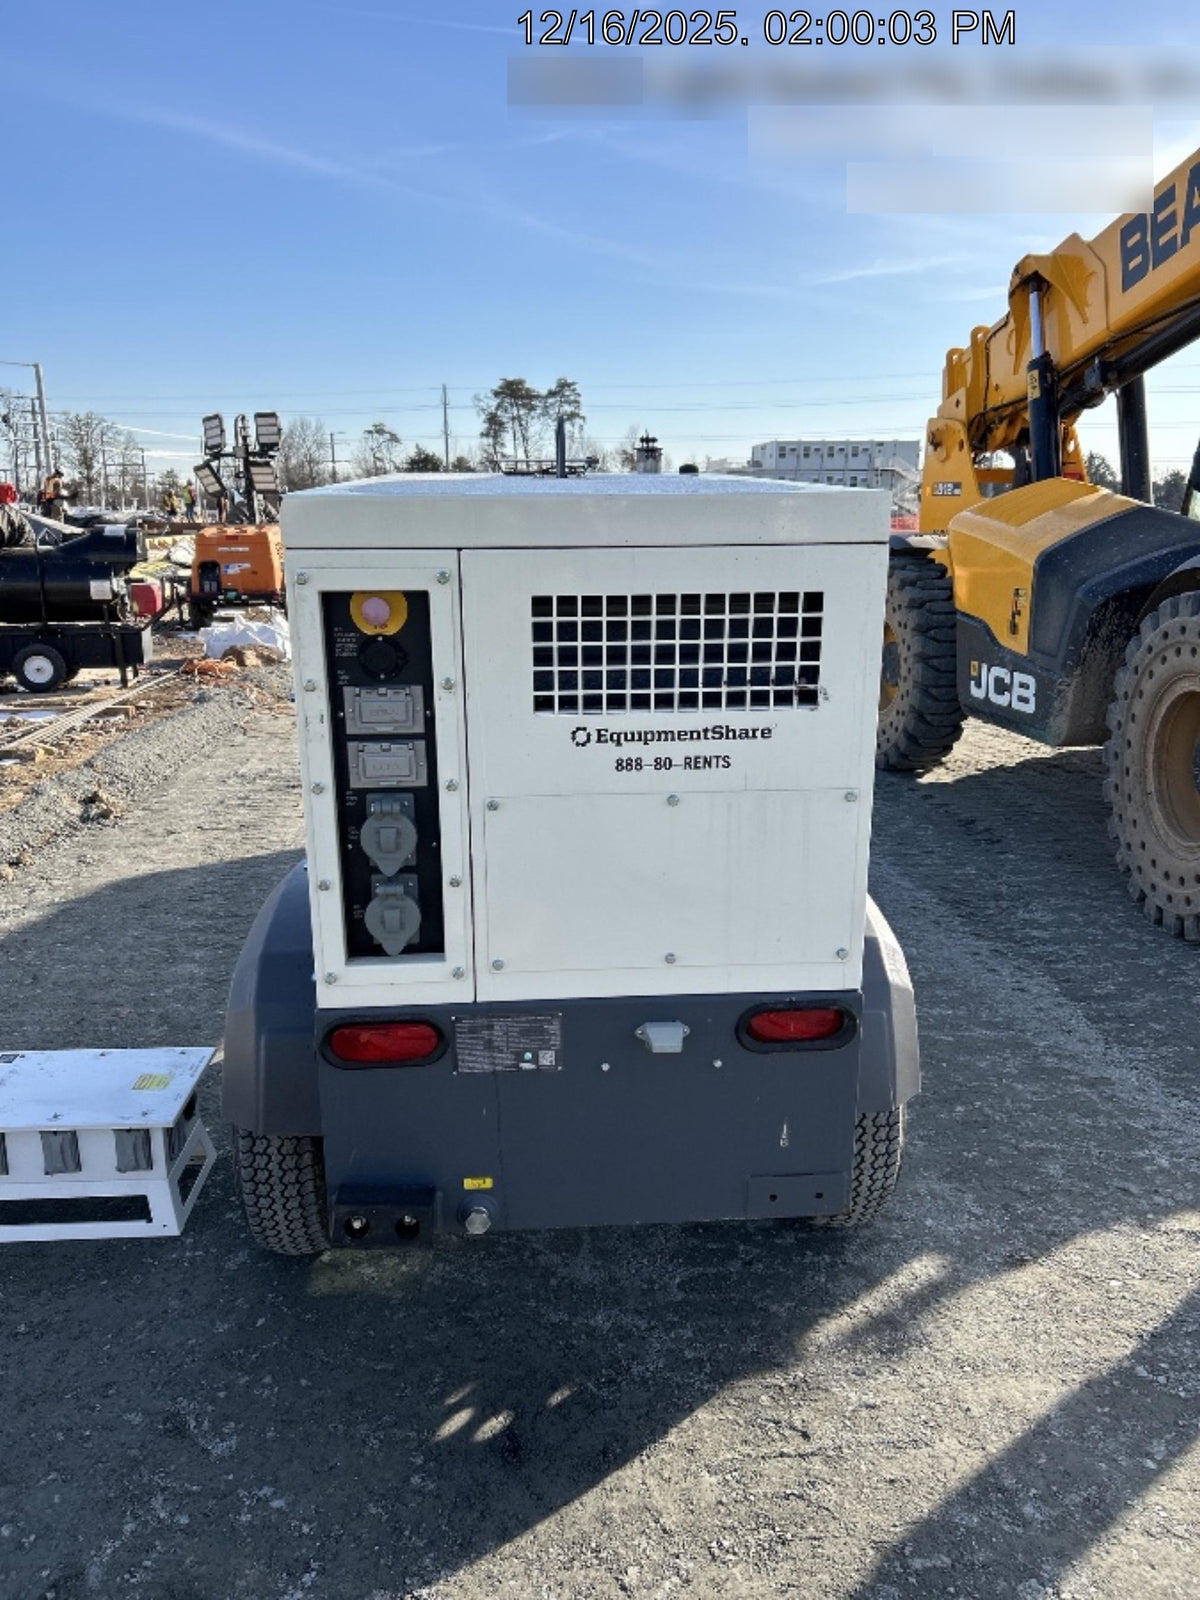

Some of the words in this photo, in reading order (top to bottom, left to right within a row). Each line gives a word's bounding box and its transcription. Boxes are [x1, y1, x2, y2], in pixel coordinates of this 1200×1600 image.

[970, 662, 1036, 714] JCB
[595, 725, 773, 747] EquipmentShare
[615, 755, 731, 772] 888-80-RENTS
